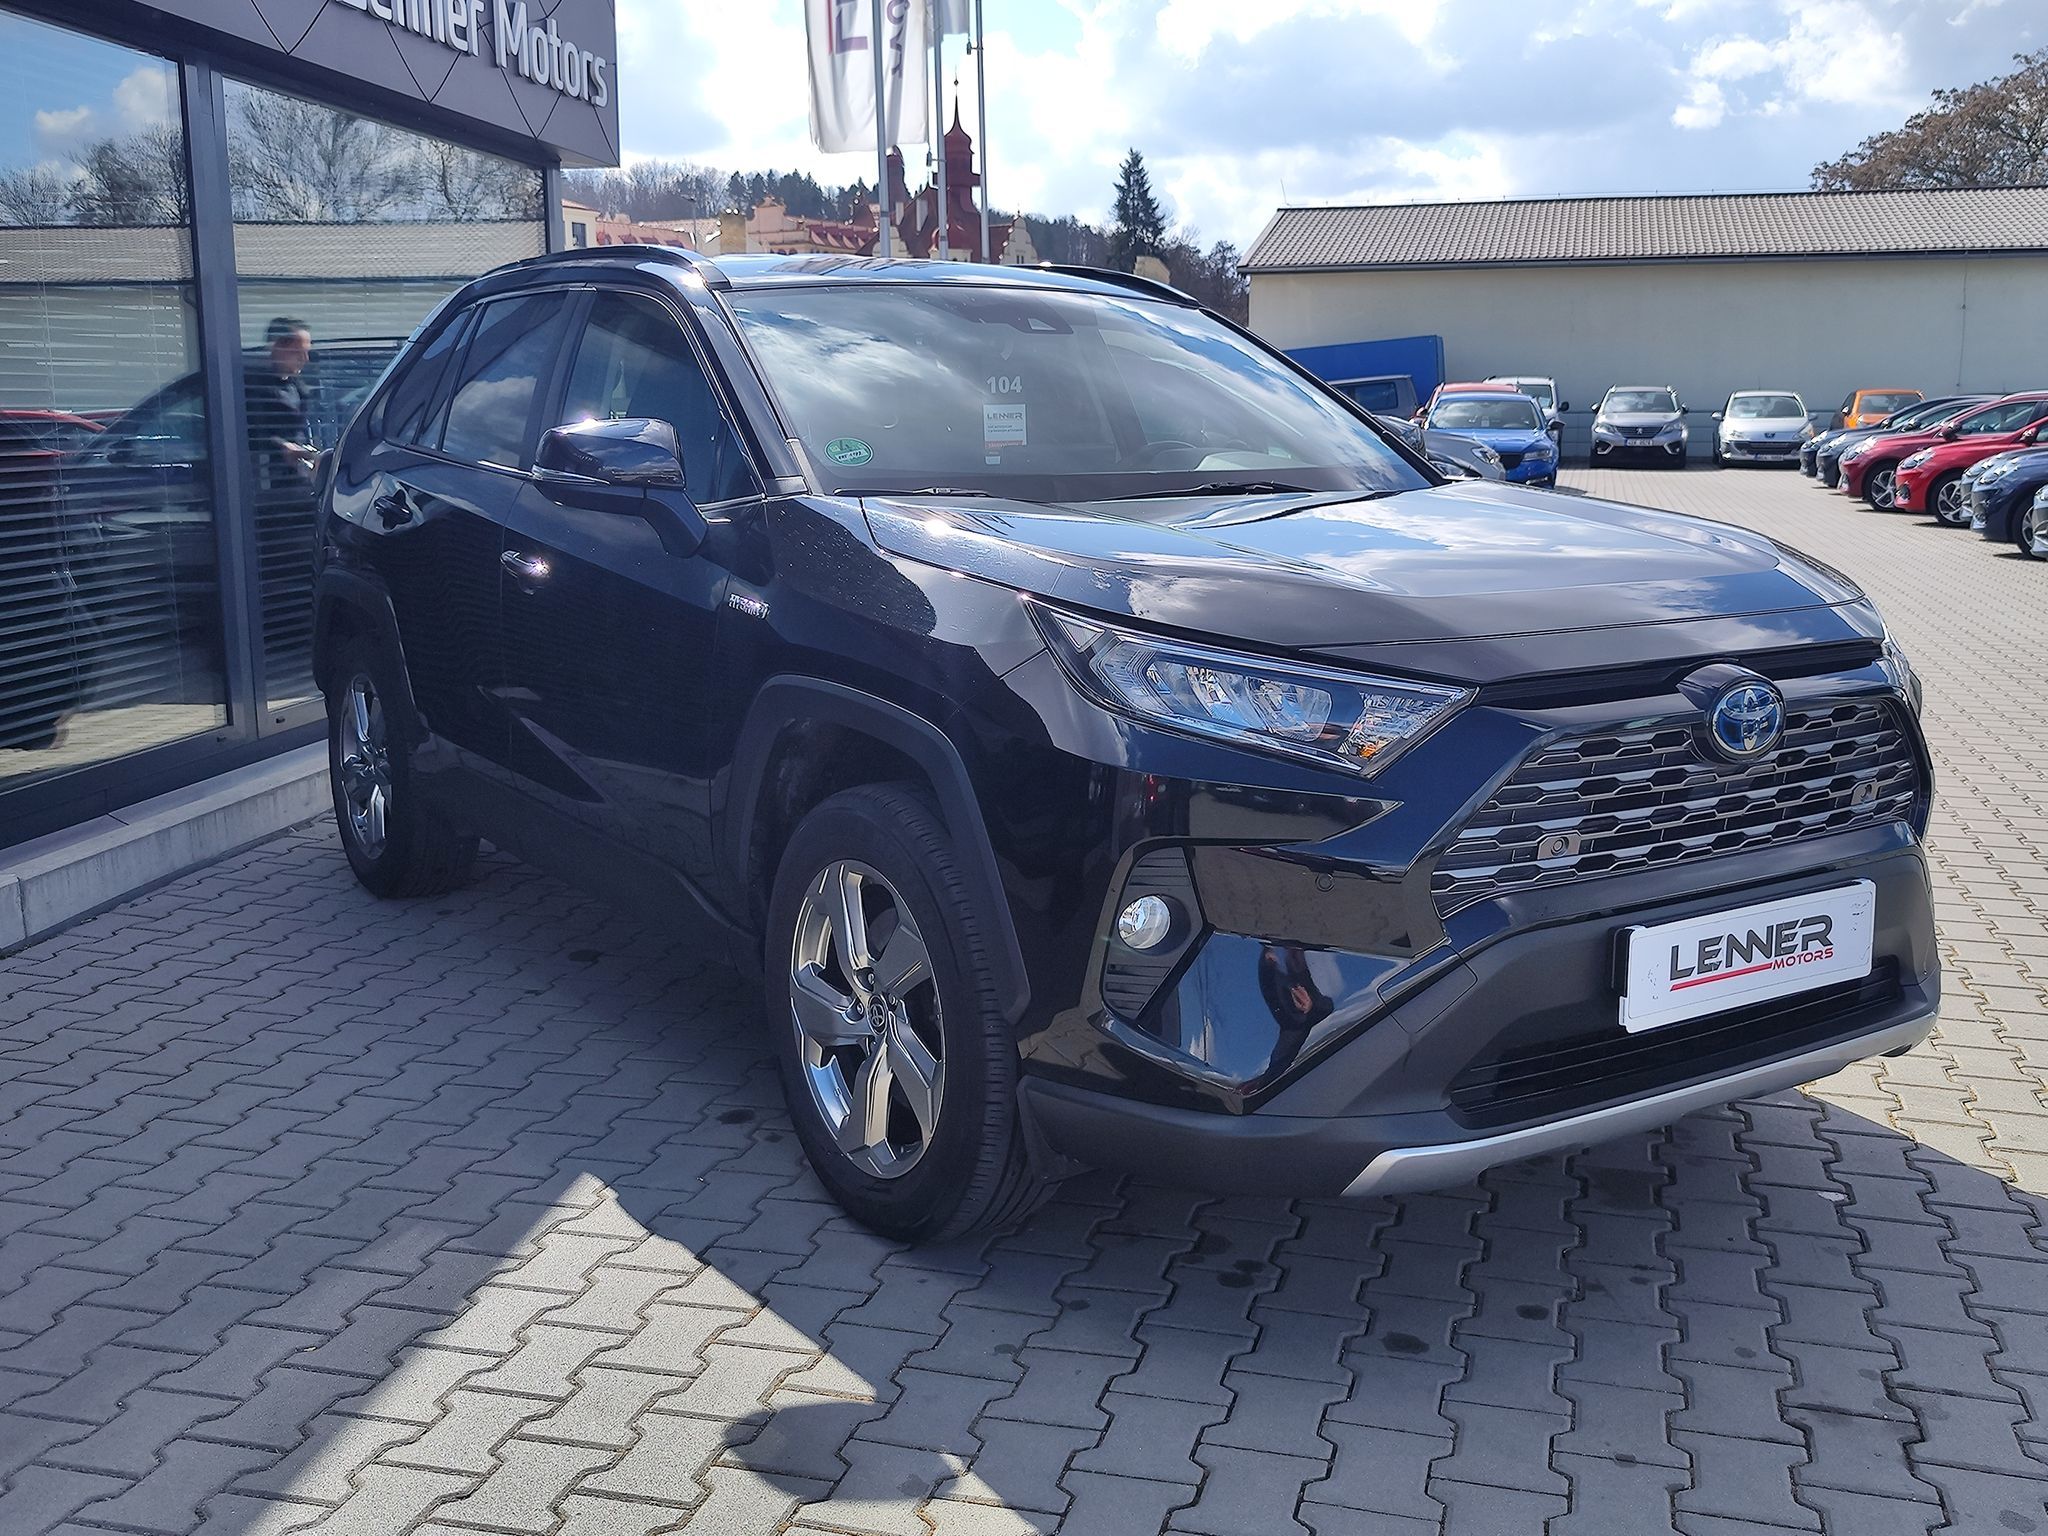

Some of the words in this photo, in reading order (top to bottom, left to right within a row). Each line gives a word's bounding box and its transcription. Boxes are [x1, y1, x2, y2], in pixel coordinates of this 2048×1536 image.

[335, 0, 485, 56] nner
[494, 0, 608, 107] Motors
[986, 376, 1022, 393] 104
[1670, 914, 1834, 981] LENNER
[1772, 947, 1834, 970] MOTORS
